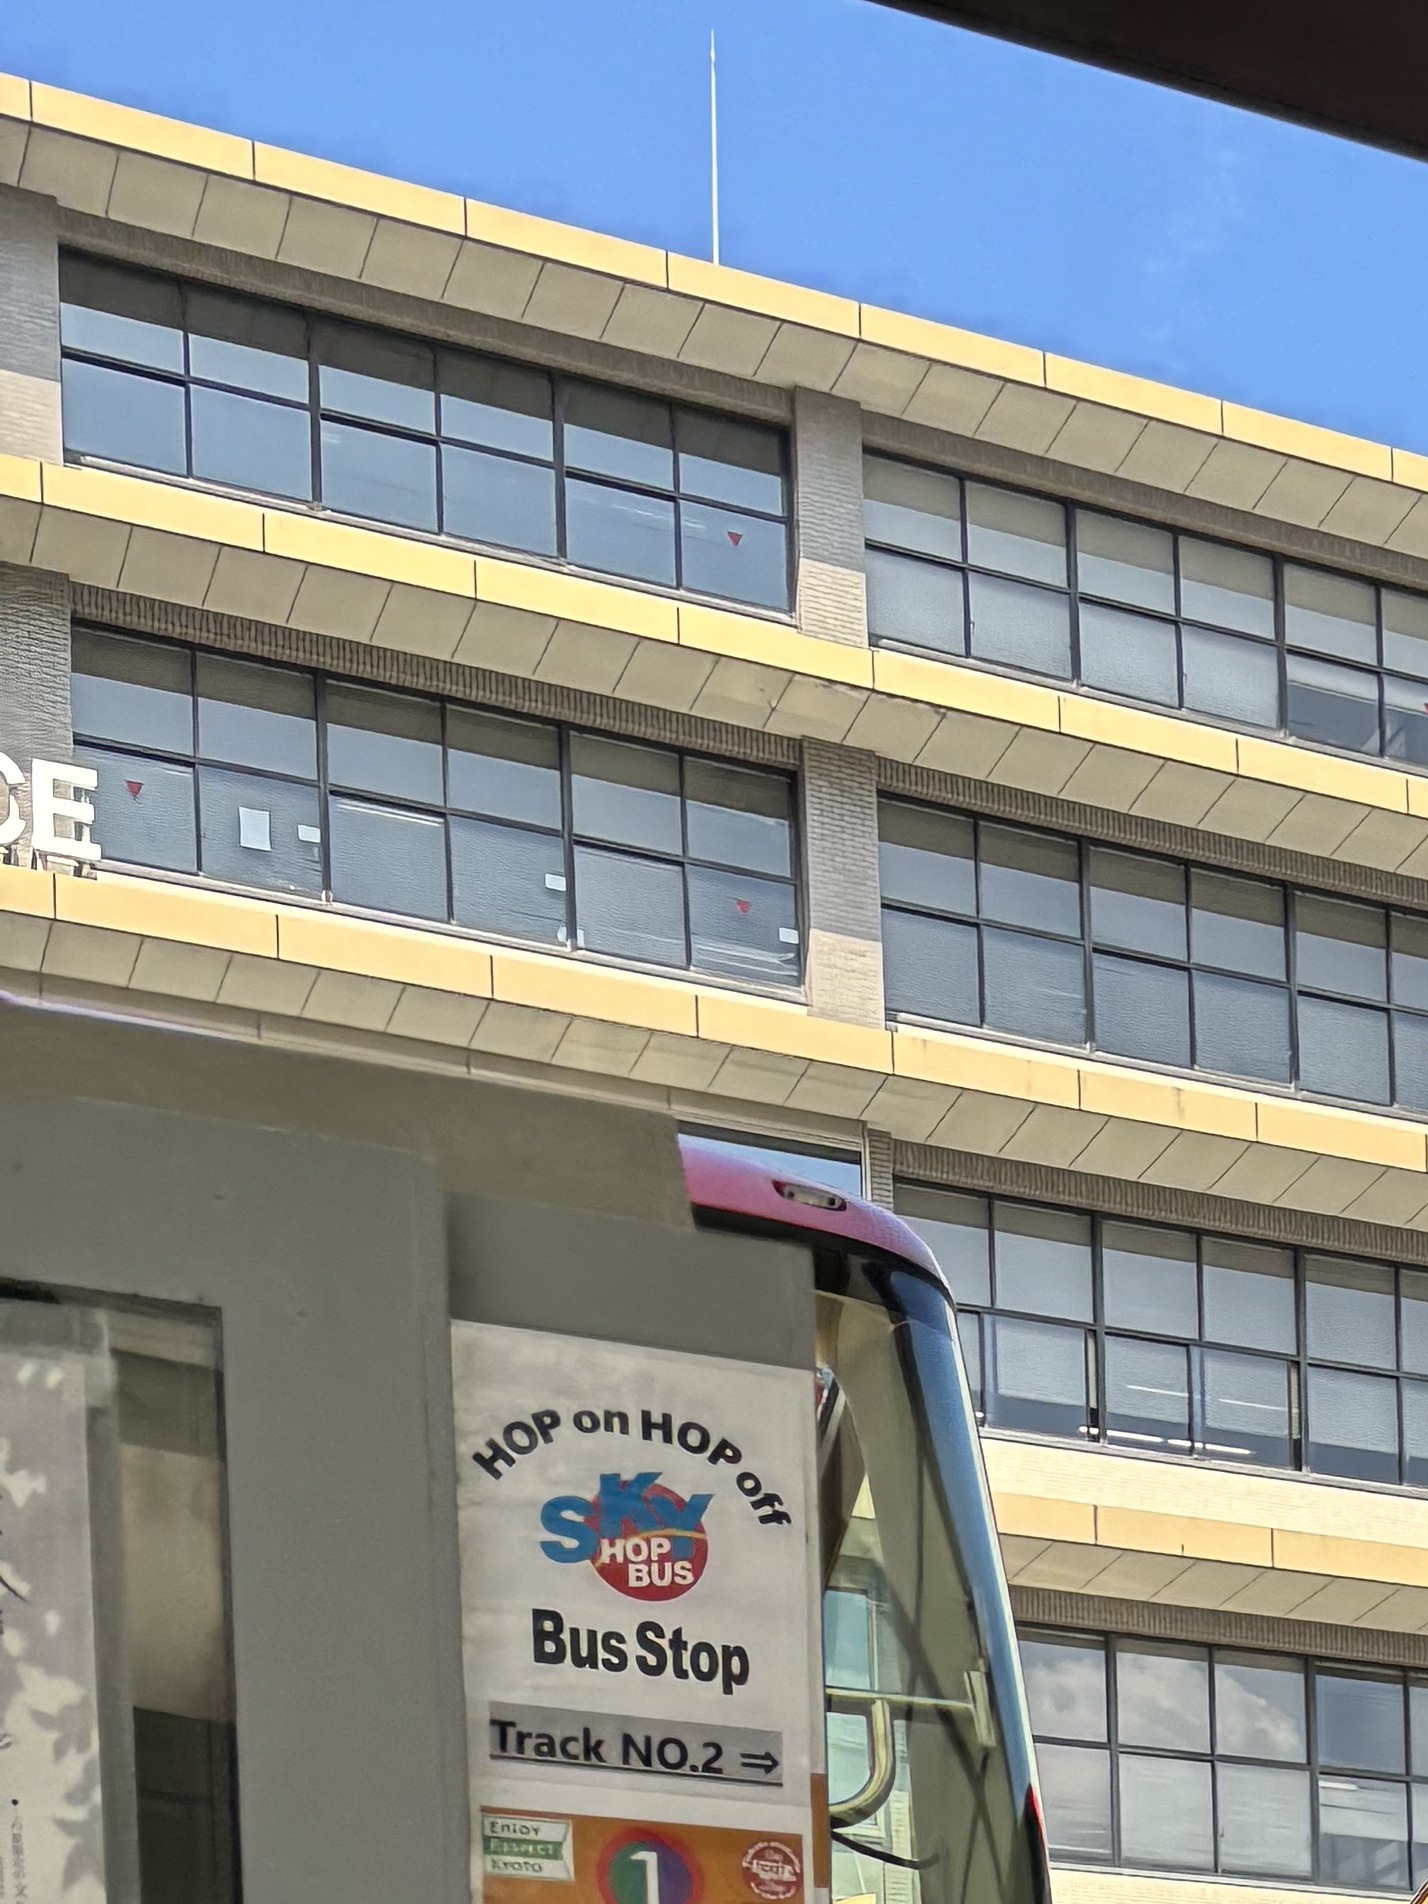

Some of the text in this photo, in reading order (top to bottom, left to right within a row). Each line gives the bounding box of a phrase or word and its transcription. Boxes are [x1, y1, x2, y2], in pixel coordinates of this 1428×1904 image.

[472, 1409, 792, 1525] HOP on HOP off
[540, 1471, 714, 1563] SKY
[600, 1536, 672, 1566] HOP
[627, 1560, 694, 1588] BUS
[531, 1608, 750, 1695] Bus Stop
[490, 1718, 724, 1774] Track NO.2
